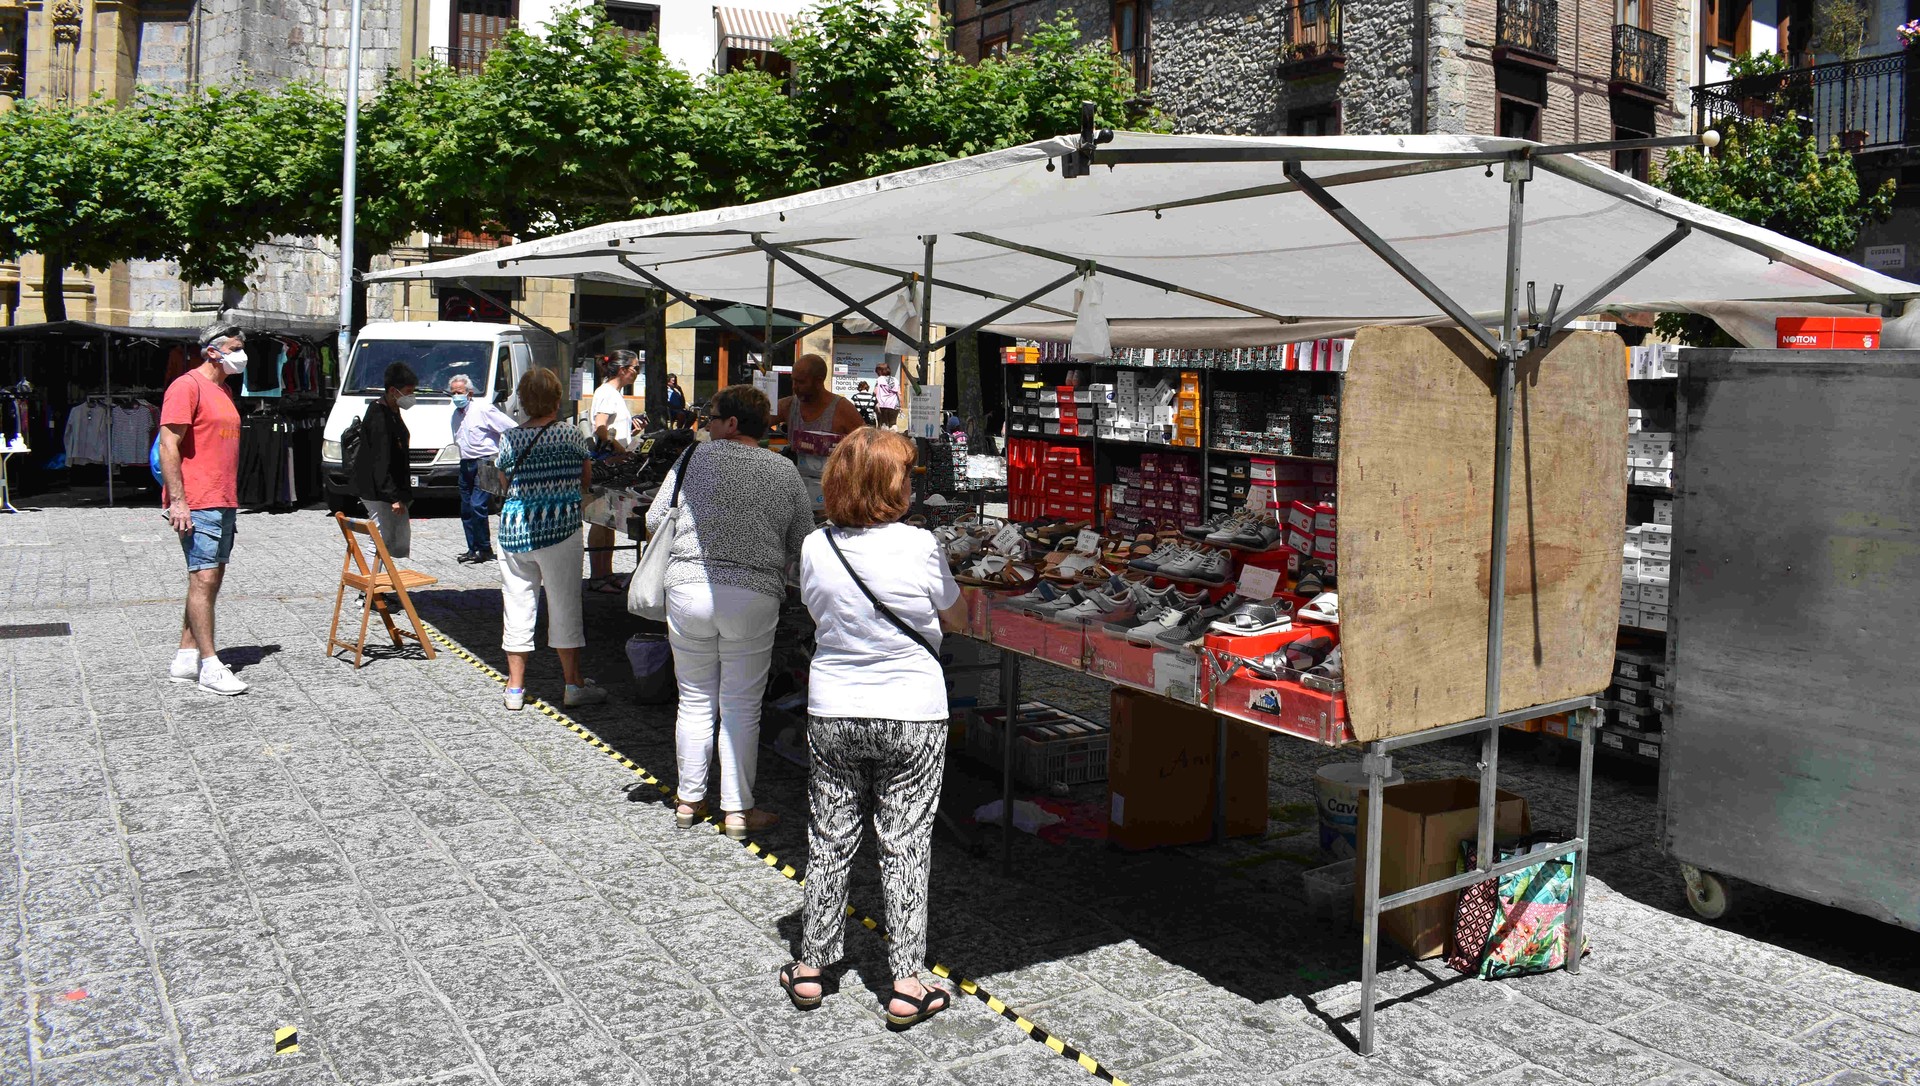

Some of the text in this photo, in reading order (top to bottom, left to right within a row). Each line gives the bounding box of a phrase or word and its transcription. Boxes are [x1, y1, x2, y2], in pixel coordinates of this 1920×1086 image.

[1782, 335, 1817, 344] NOTTON
[997, 529, 1010, 543] TODO
[1297, 714, 1317, 725] NOTTON
